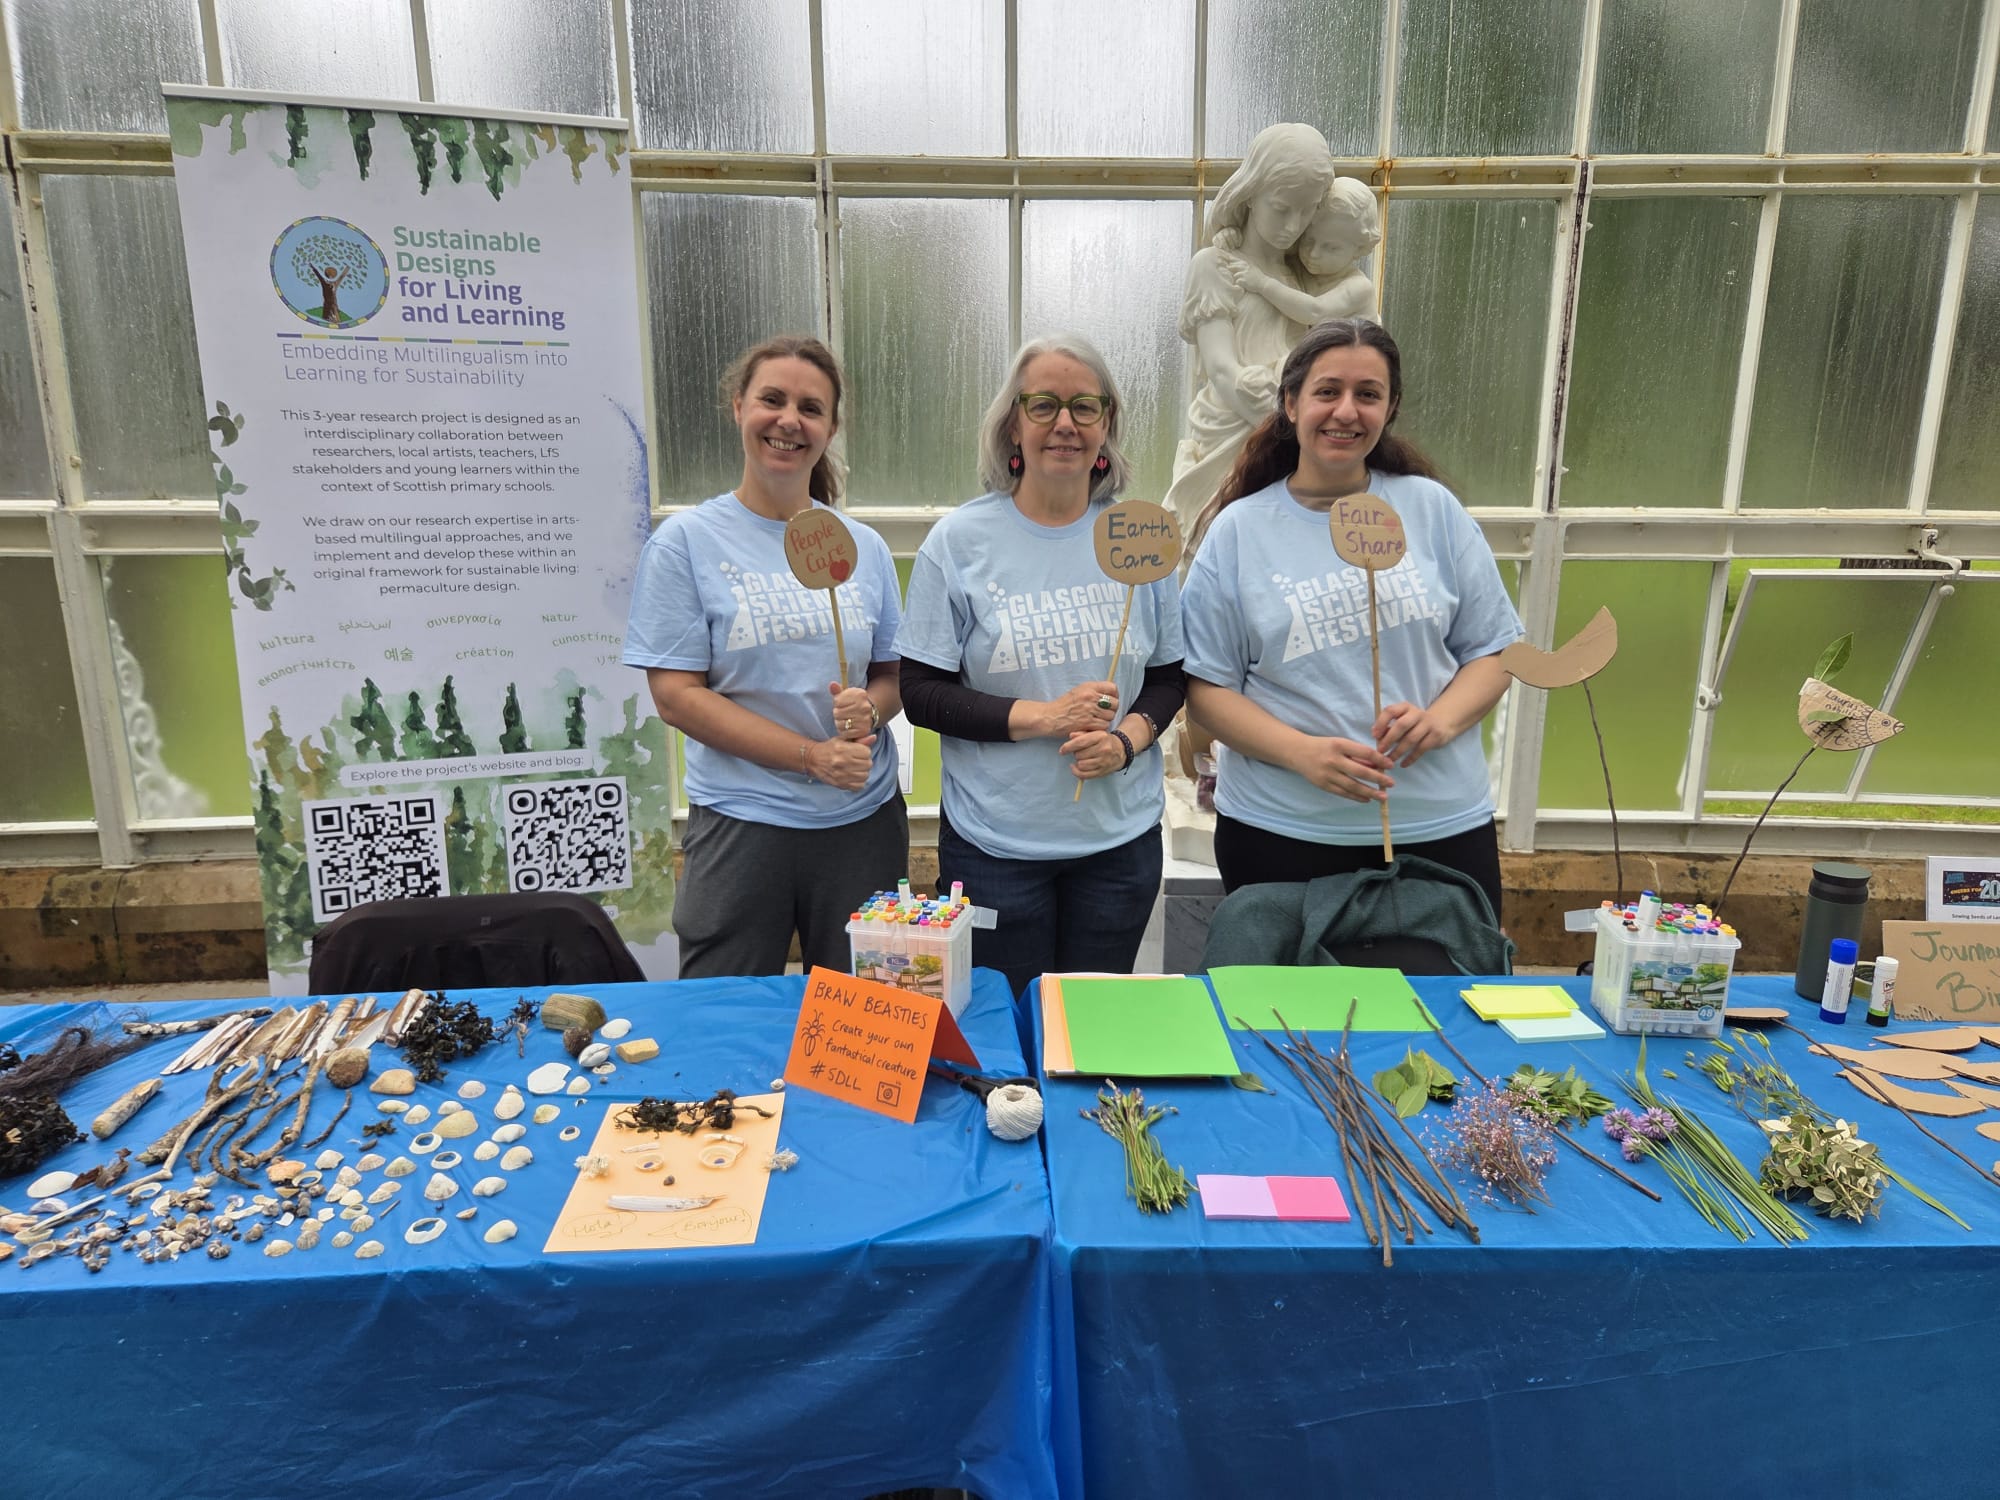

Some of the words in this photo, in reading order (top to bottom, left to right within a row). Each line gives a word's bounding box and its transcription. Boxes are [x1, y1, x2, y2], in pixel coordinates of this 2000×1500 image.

[393, 225, 541, 253] Sustainable
[396, 251, 496, 278] Designs
[398, 276, 436, 298] for
[445, 278, 523, 305] Living
[402, 303, 449, 324] and
[456, 304, 566, 331] Learning
[282, 343, 389, 365] Embedding
[394, 347, 528, 366] Multilingualism
[535, 350, 568, 366] into
[284, 364, 368, 384] Learning
[374, 366, 399, 382] for
[406, 367, 525, 388] Sustainability
[280, 409, 311, 421] This
[313, 410, 356, 424] 3-year
[360, 410, 418, 422] research
[421, 413, 468, 425] project
[471, 412, 482, 423] is
[485, 413, 544, 426] designed
[548, 415, 562, 424] as
[565, 415, 581, 424] an
[304, 428, 415, 441] interdisciplinary
[418, 429, 504, 440] collaboration
[508, 430, 564, 441] between
[312, 446, 396, 458] researchers,
[399, 446, 429, 457] local
[433, 446, 476, 458] artists,
[479, 447, 537, 459] teachers,
[540, 447, 560, 458] LfS
[292, 464, 382, 474] stakeholders
[385, 464, 411, 474] and
[414, 466, 457, 477] young
[460, 464, 513, 475] learners
[515, 464, 556, 475] within
[559, 464, 580, 475] the
[321, 481, 374, 492] context
[377, 481, 390, 492] of
[393, 481, 447, 492] Scottish
[450, 481, 501, 493] primary
[504, 481, 555, 492] schools.
[302, 516, 327, 527] We
[329, 516, 365, 527] draw
[368, 517, 386, 526] on
[389, 517, 412, 526] our
[415, 514, 471, 526] research
[475, 514, 534, 527] expertise
[537, 514, 548, 525] in
[551, 514, 580, 525] arts-
[1108, 512, 1174, 540] Earth
[1338, 501, 1384, 527] Fair
[314, 533, 356, 544] based
[360, 532, 442, 545] multilingual
[445, 531, 524, 544] approaches,
[527, 531, 551, 541] and
[554, 532, 573, 541] we
[789, 519, 835, 555] People
[1344, 530, 1403, 556] Share
[313, 550, 391, 563] implement
[394, 549, 420, 560] and
[423, 548, 476, 561] develop
[479, 548, 515, 558] these
[517, 547, 558, 558] within
[560, 548, 576, 558] an
[805, 543, 847, 573] Care
[1110, 546, 1165, 570] Care
[313, 567, 366, 581] original
[369, 565, 443, 578] framework
[446, 565, 464, 576] for
[467, 564, 541, 576] sustainable
[379, 582, 471, 596] permaculture
[473, 581, 520, 593] design.
[1008, 582, 1126, 619] GLASGOW
[1301, 570, 1429, 624] SCIENCE
[426, 613, 502, 629] συνεργασία
[541, 614, 578, 624] Natur
[258, 633, 316, 652] kultura
[383, 645, 415, 662] 예술
[455, 646, 515, 661] création
[257, 657, 356, 687] екологічність
[350, 768, 399, 783] Explore
[401, 766, 423, 778] the
[480, 757, 527, 772] website
[530, 756, 553, 768] and
[555, 754, 584, 768] blog:
[814, 981, 858, 1008] BRAW
[863, 996, 929, 1030] BEASTIES
[1699, 1008, 1713, 1018] 48
[832, 1019, 863, 1038] Create
[867, 1032, 890, 1045] your
[894, 1040, 914, 1052] own
[825, 1037, 876, 1065] fantastical
[876, 1058, 918, 1081] creature
